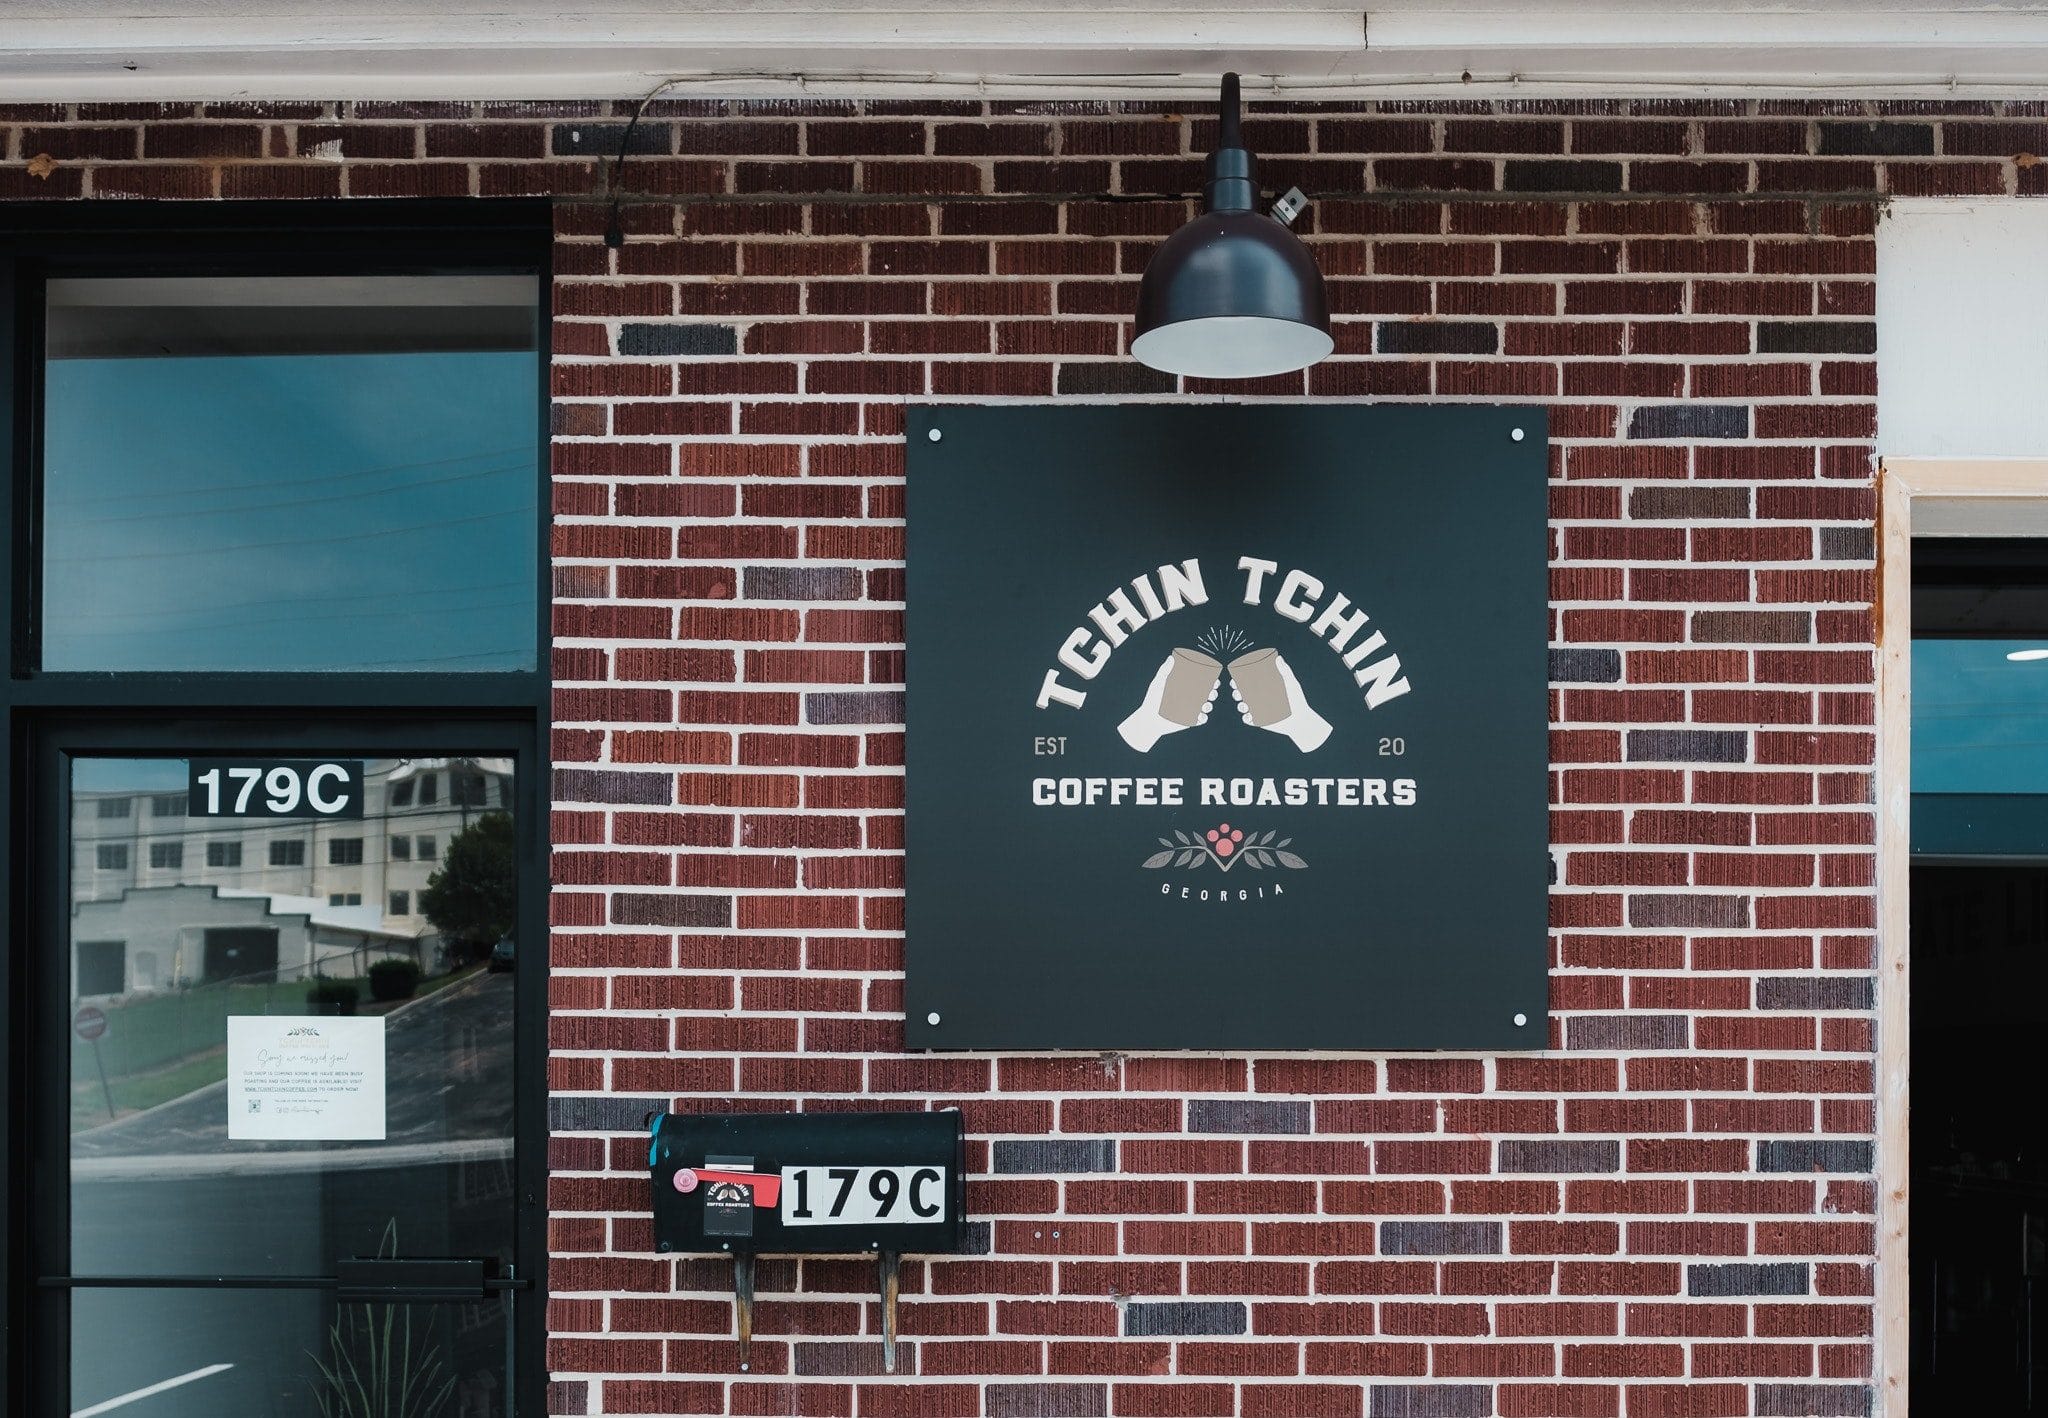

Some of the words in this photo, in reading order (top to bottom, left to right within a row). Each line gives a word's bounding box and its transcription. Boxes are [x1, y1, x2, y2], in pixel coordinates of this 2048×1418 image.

[1036, 558, 1210, 711] TCHIN
[1238, 555, 1411, 711] TCHIN
[1034, 736, 1067, 756] EST
[1378, 737, 1405, 756] 20
[198, 763, 350, 814] 179C
[1032, 777, 1184, 806] COFFEE
[1200, 777, 1417, 806] ROASTERS
[1161, 883, 1284, 902] GEORGIA
[792, 1168, 940, 1218] 179C
